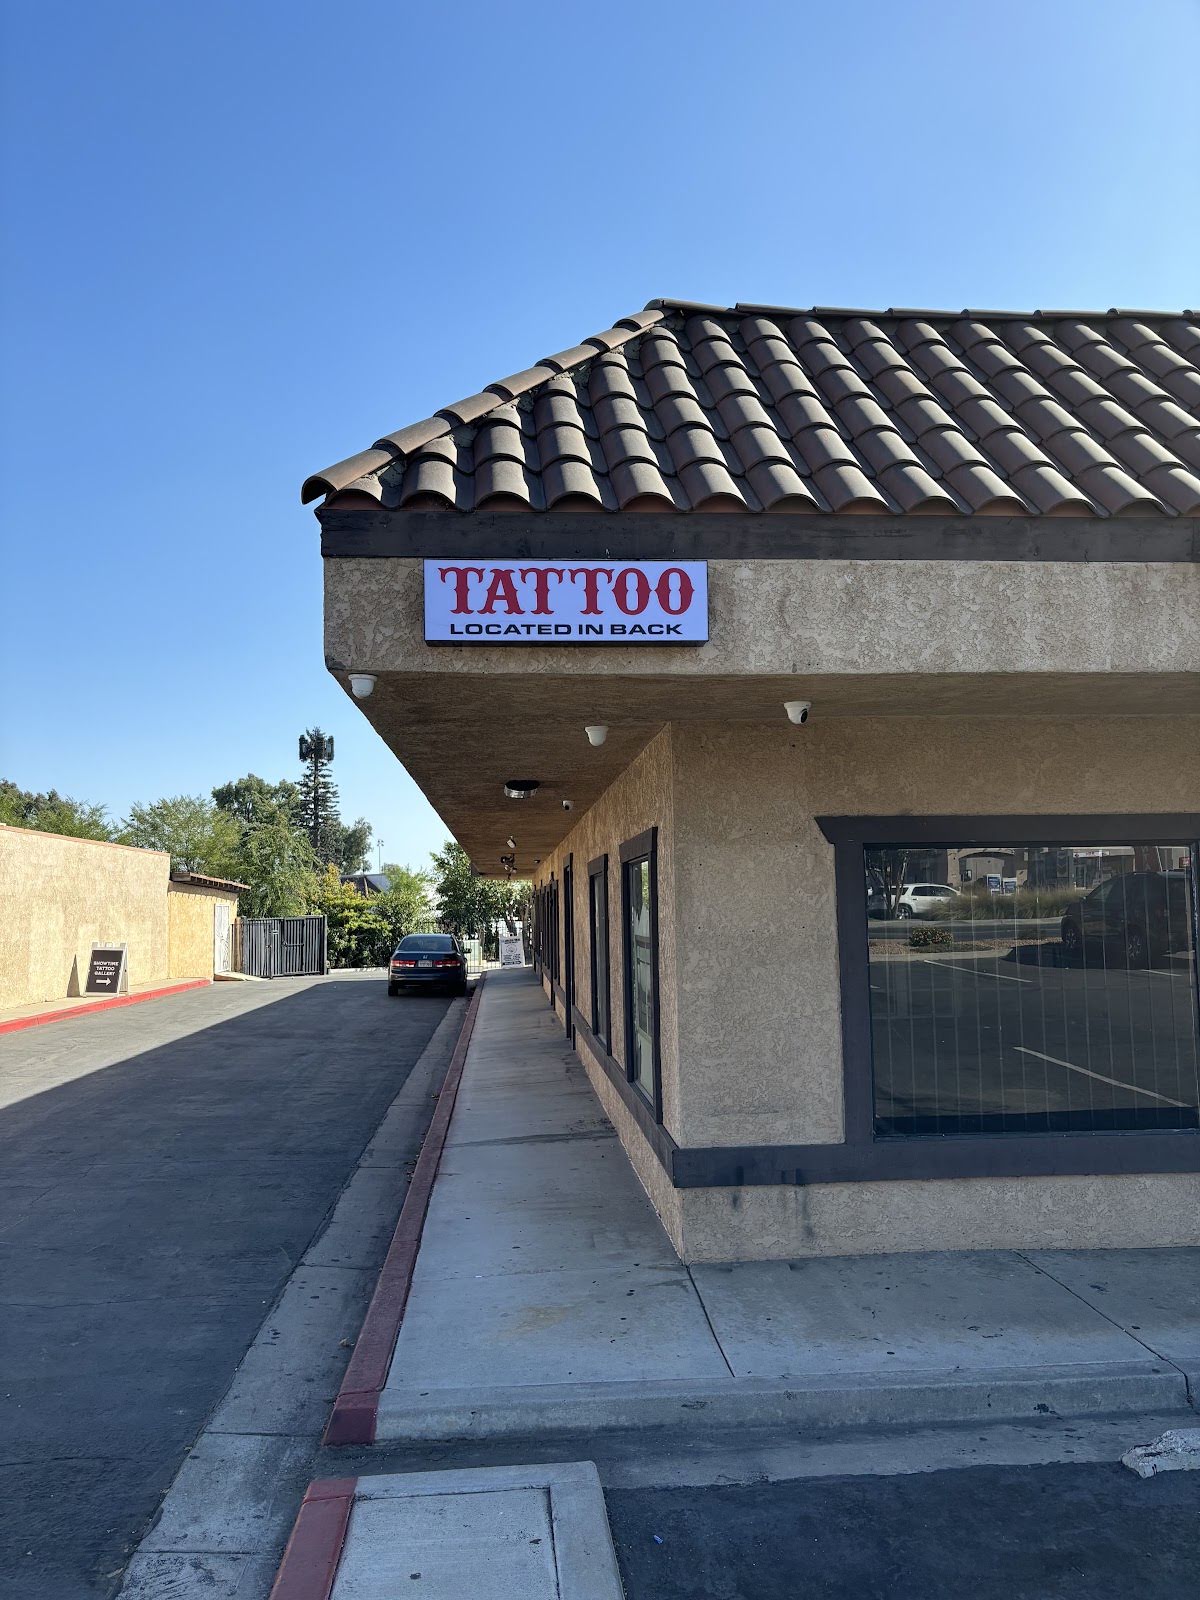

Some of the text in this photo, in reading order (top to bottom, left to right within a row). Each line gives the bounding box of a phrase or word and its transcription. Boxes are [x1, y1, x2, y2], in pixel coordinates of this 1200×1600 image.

[438, 567, 695, 615] TATTOO
[450, 623, 683, 635] LOCATED IN BACK
